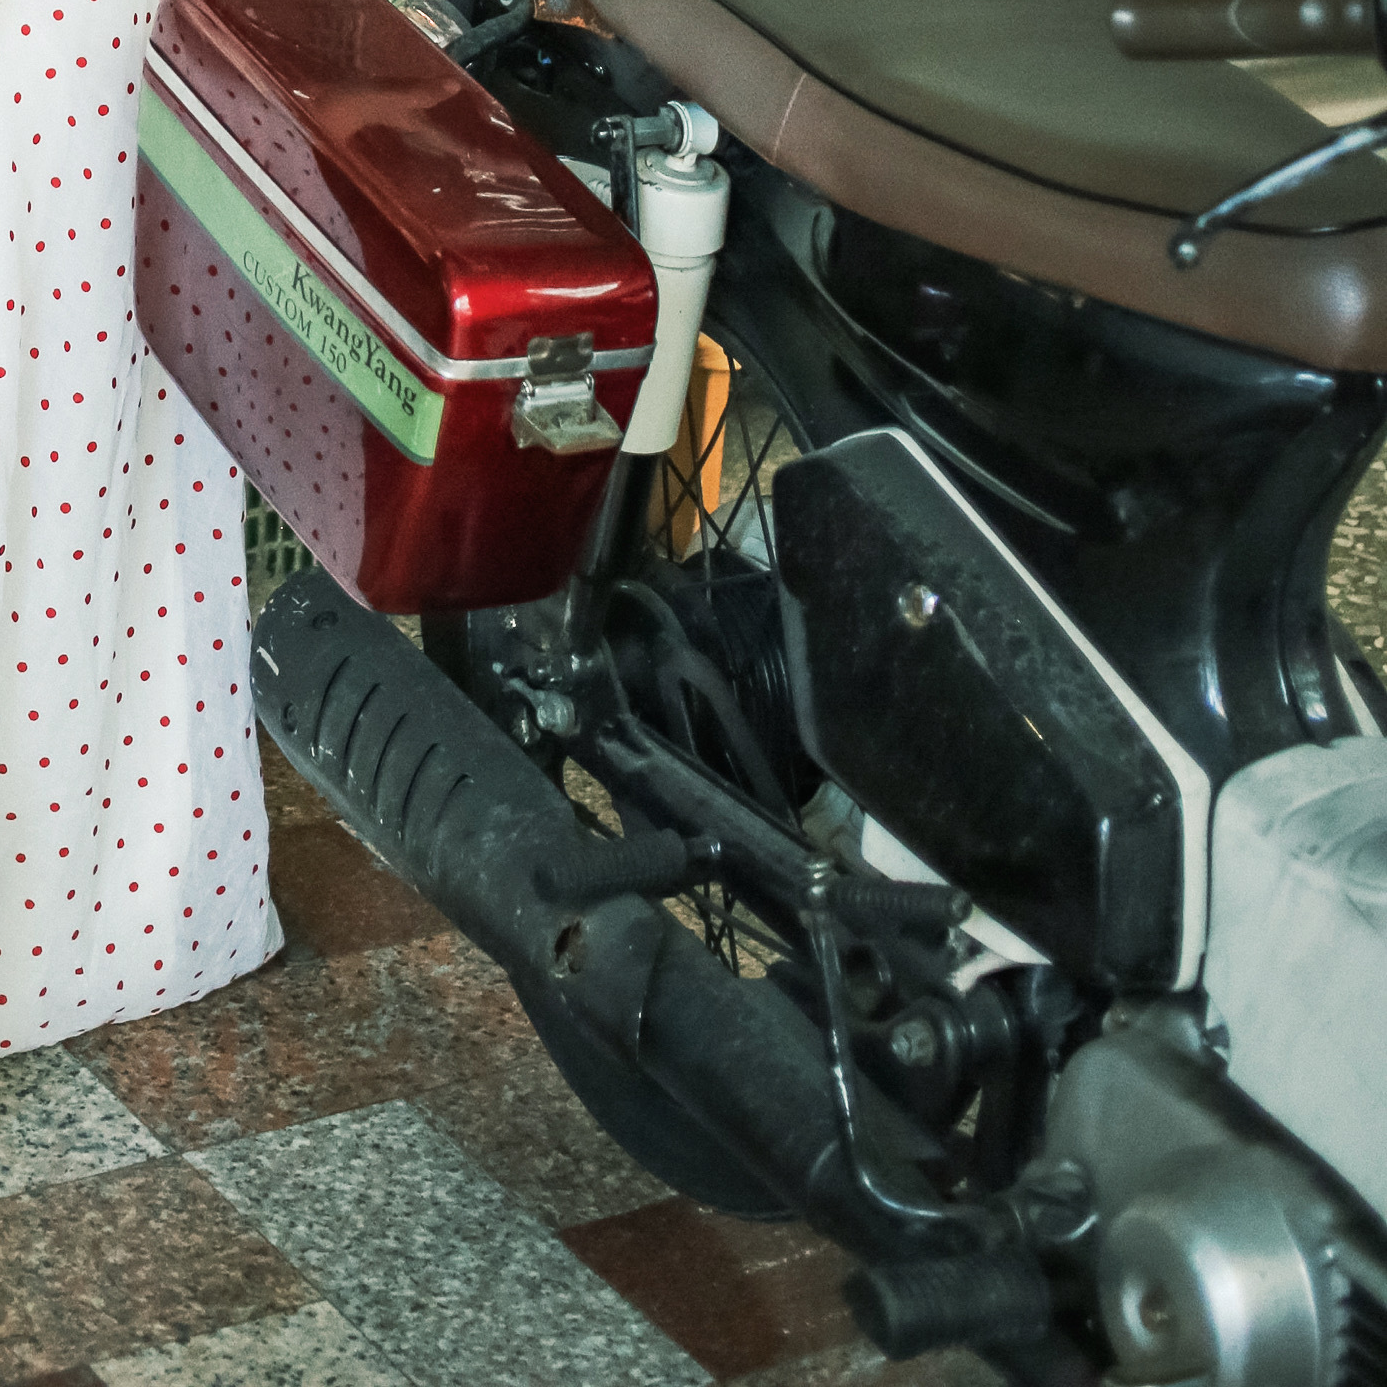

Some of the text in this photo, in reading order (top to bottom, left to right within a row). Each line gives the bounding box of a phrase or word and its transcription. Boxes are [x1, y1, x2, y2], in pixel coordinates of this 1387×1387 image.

[244, 250, 347, 373] CUSTOM 150
[292, 261, 417, 416] KwangYang
